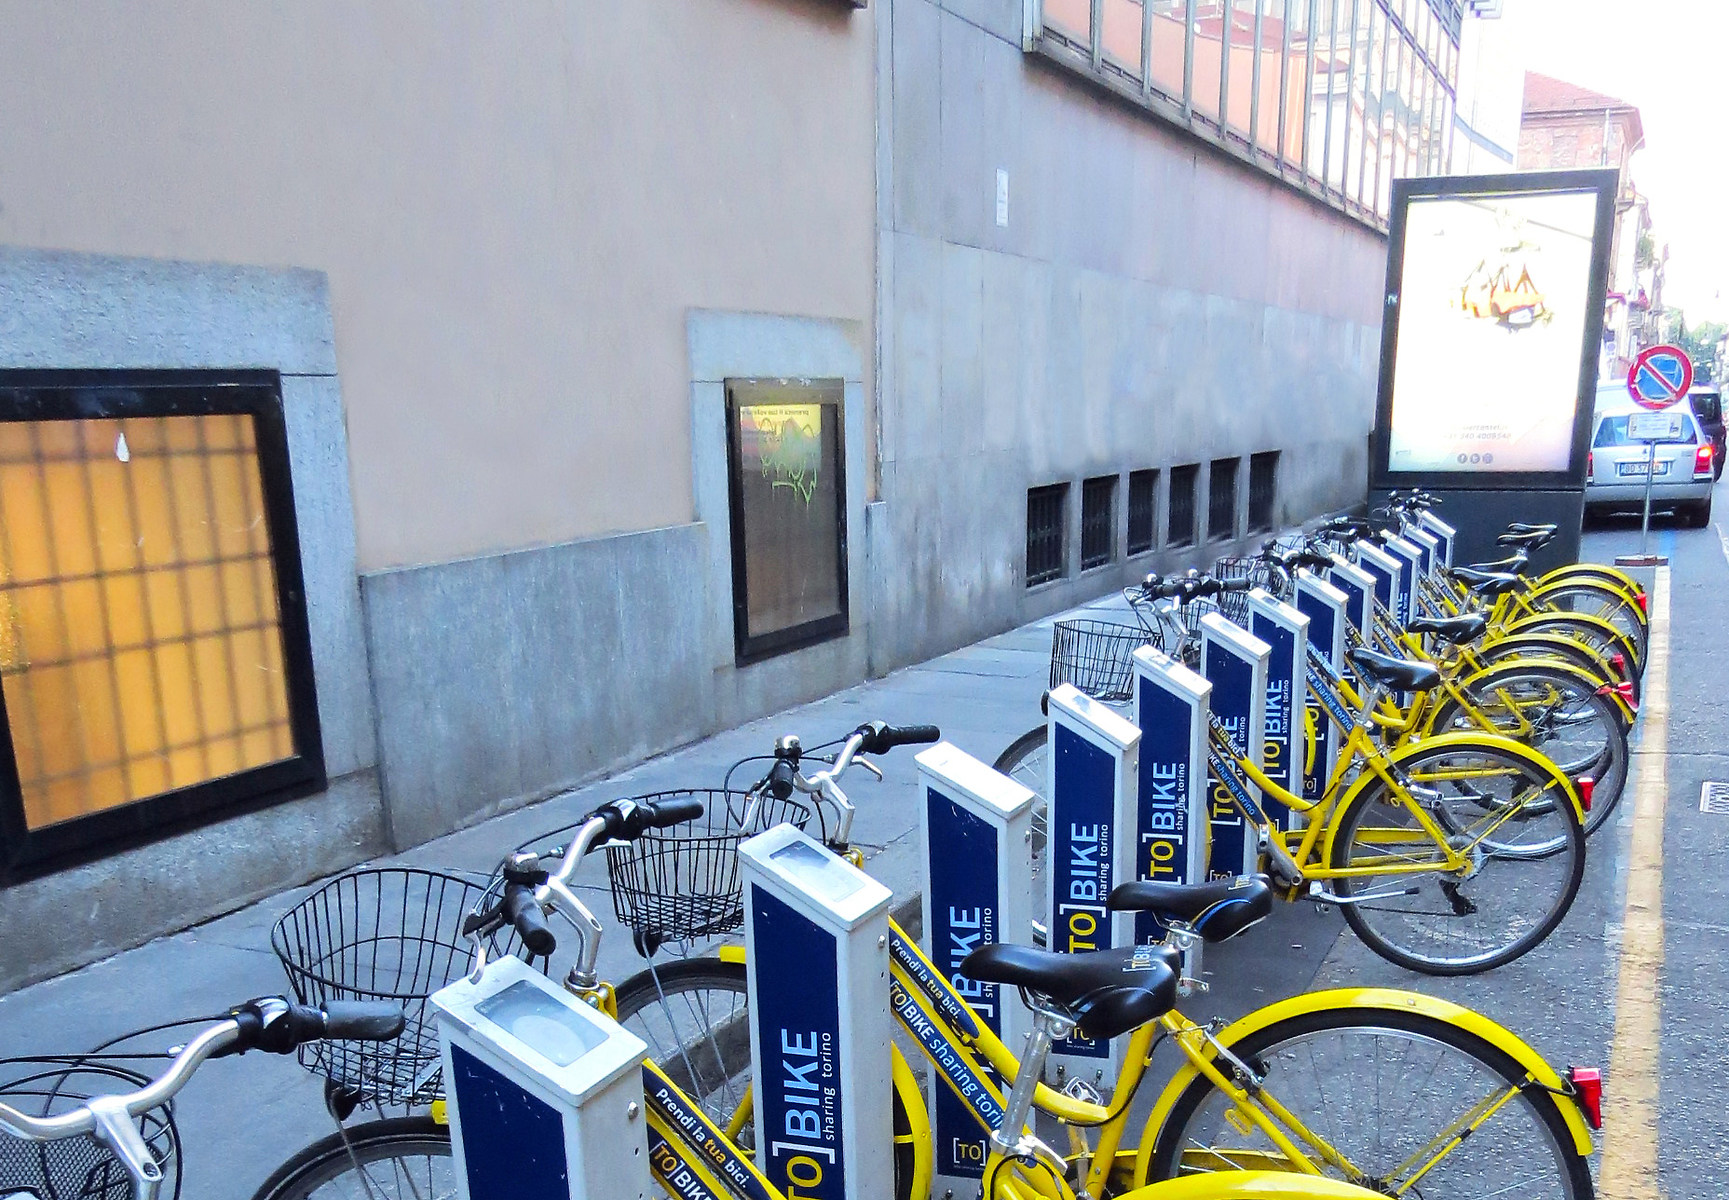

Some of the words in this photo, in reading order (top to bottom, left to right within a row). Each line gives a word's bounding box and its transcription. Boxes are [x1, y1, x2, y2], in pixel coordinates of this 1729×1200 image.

[1177, 763, 1186, 792] torino
[1236, 789, 1255, 816] torino
[1098, 824, 1109, 857] torino
[1141, 762, 1183, 885] [TO]BIKE
[1060, 823, 1106, 954] TO]BIKE
[1098, 862, 1110, 901] sharing
[891, 939, 921, 974] Prendi
[918, 968, 928, 982] la
[927, 979, 944, 1000] tua
[942, 995, 961, 1019] bici.
[819, 1032, 832, 1078] torino
[930, 1038, 978, 1097] sharing
[975, 1093, 1005, 1128] tori
[656, 1088, 697, 1134] Prendi
[692, 1126, 706, 1143] la
[703, 1138, 726, 1164] tua
[723, 1160, 750, 1189] bici.
[821, 1087, 836, 1141] sharing
[953, 1137, 986, 1167] [TO]
